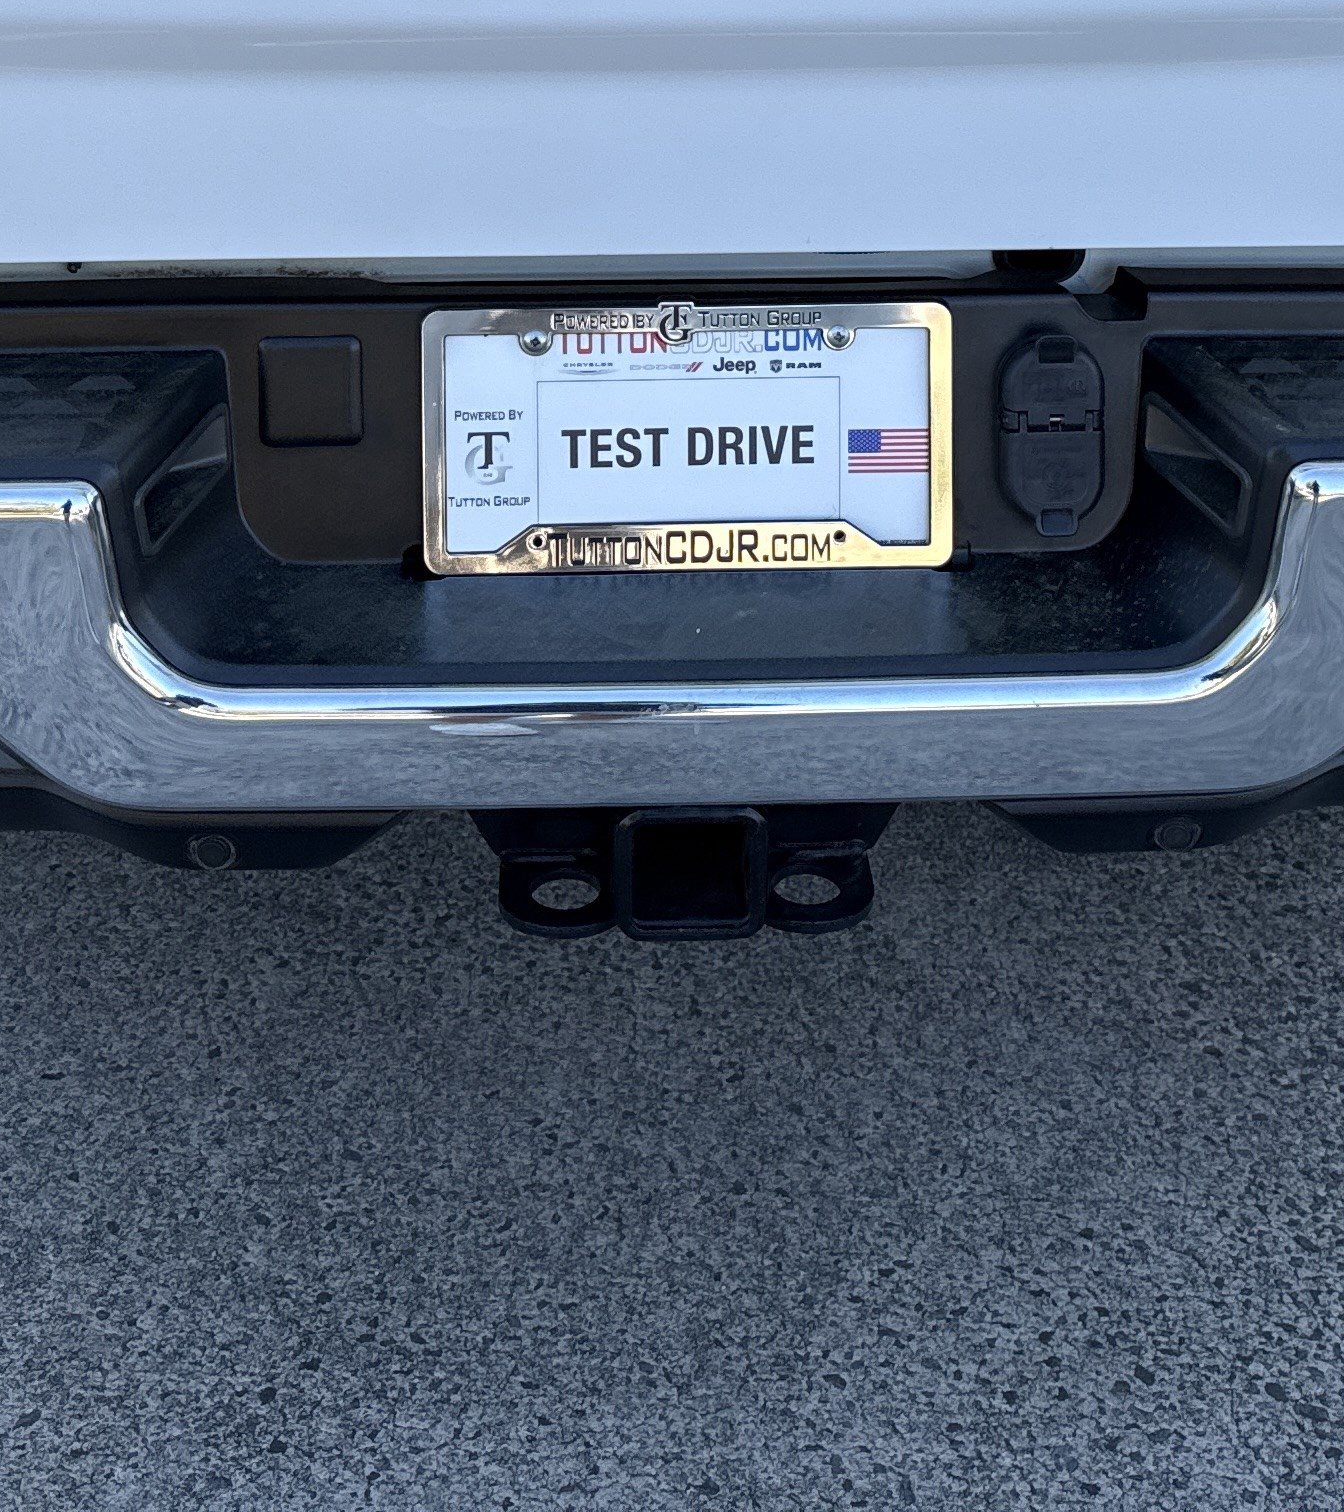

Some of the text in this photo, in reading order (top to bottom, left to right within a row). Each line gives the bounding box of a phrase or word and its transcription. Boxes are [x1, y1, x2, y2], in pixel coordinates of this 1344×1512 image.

[713, 357, 756, 375] Jeep
[561, 424, 814, 468] TEST DRIVE
